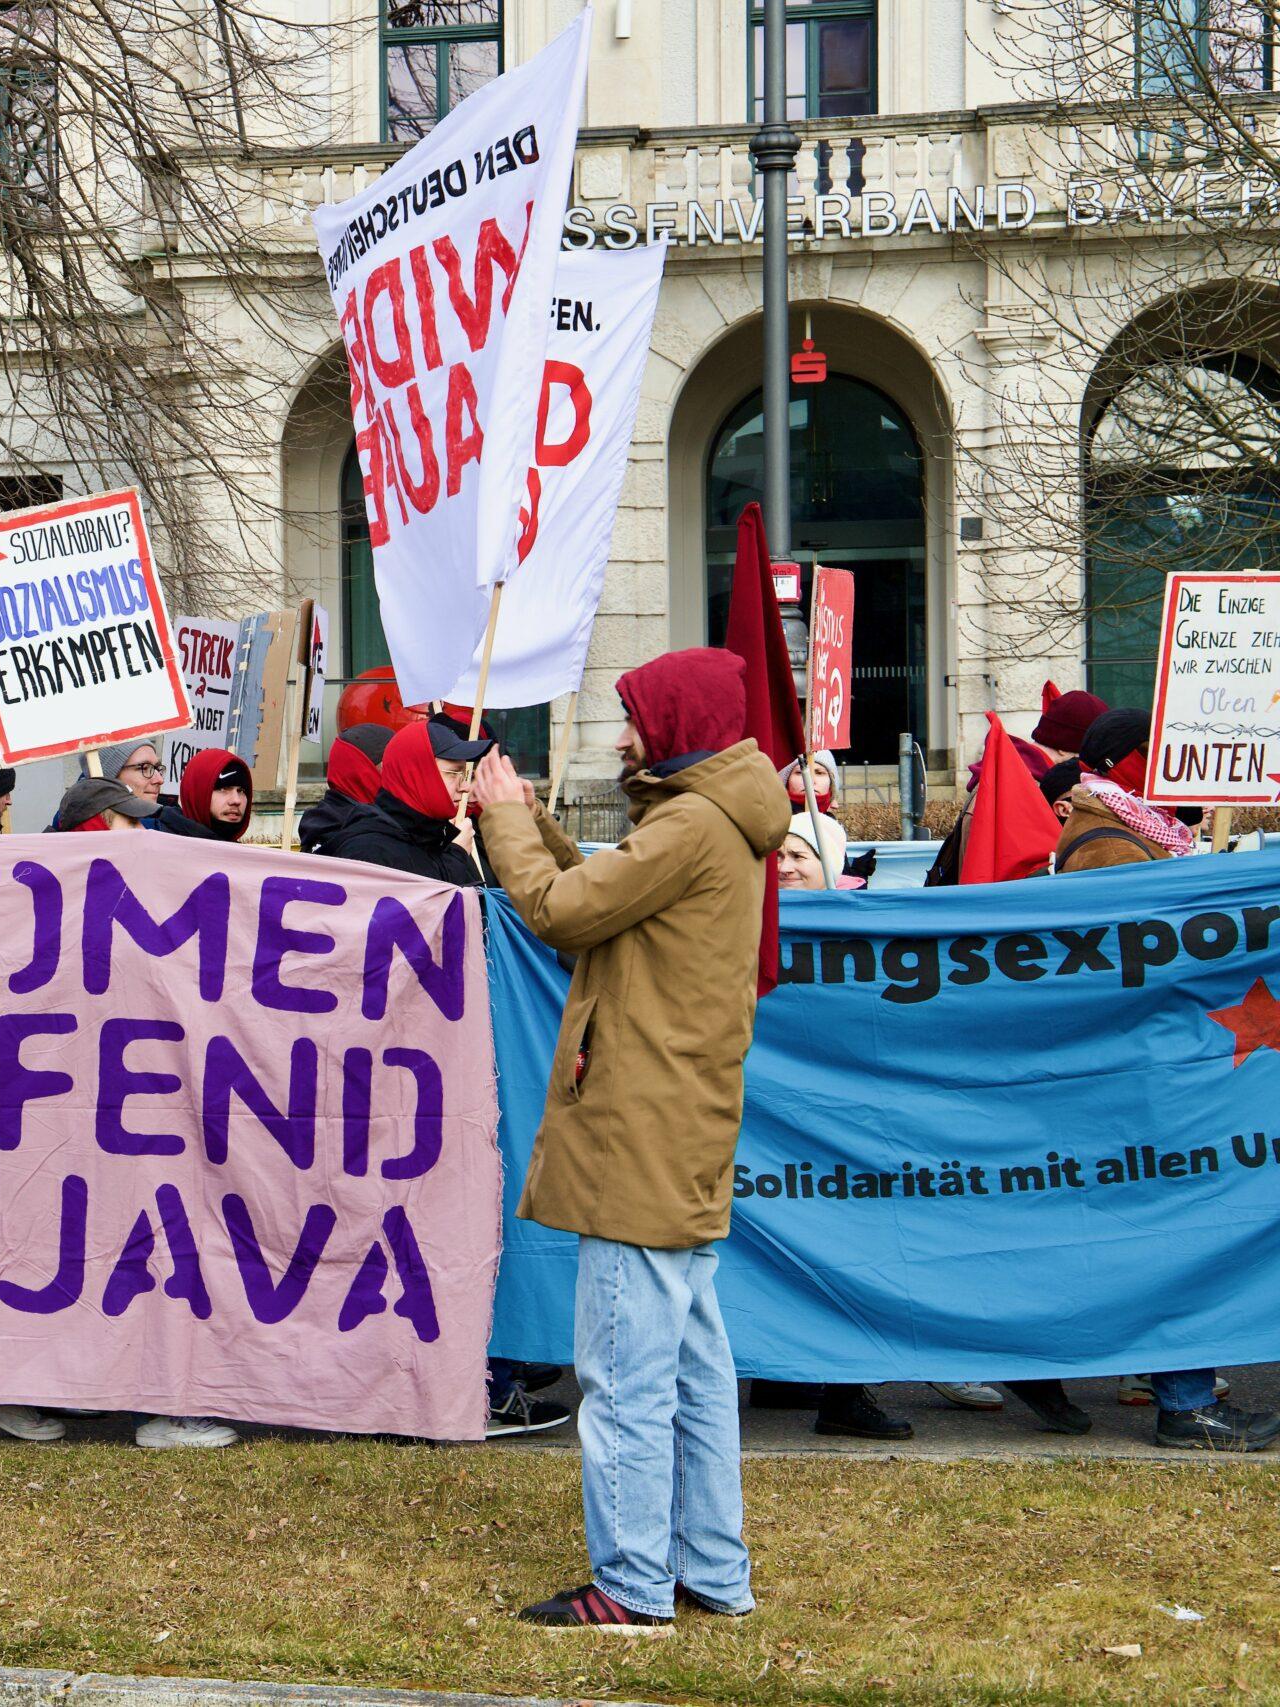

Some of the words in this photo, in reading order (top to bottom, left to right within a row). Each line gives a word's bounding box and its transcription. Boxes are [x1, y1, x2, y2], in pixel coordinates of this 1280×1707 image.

[562, 183, 1037, 251] SSENVERBAND
[9, 510, 131, 565] SOZIALABBAU?
[178, 626, 234, 680] STREIK
[1173, 660, 1199, 675] WIR
[1204, 658, 1272, 675] ZWISCHEN
[190, 704, 225, 732] NDET
[1162, 742, 1266, 783] UNTEN
[778, 905, 1280, 1005] ungsexpor
[733, 1160, 989, 1201] Solidarität
[999, 1151, 1085, 1194] mit
[1096, 1145, 1219, 1184] allen
